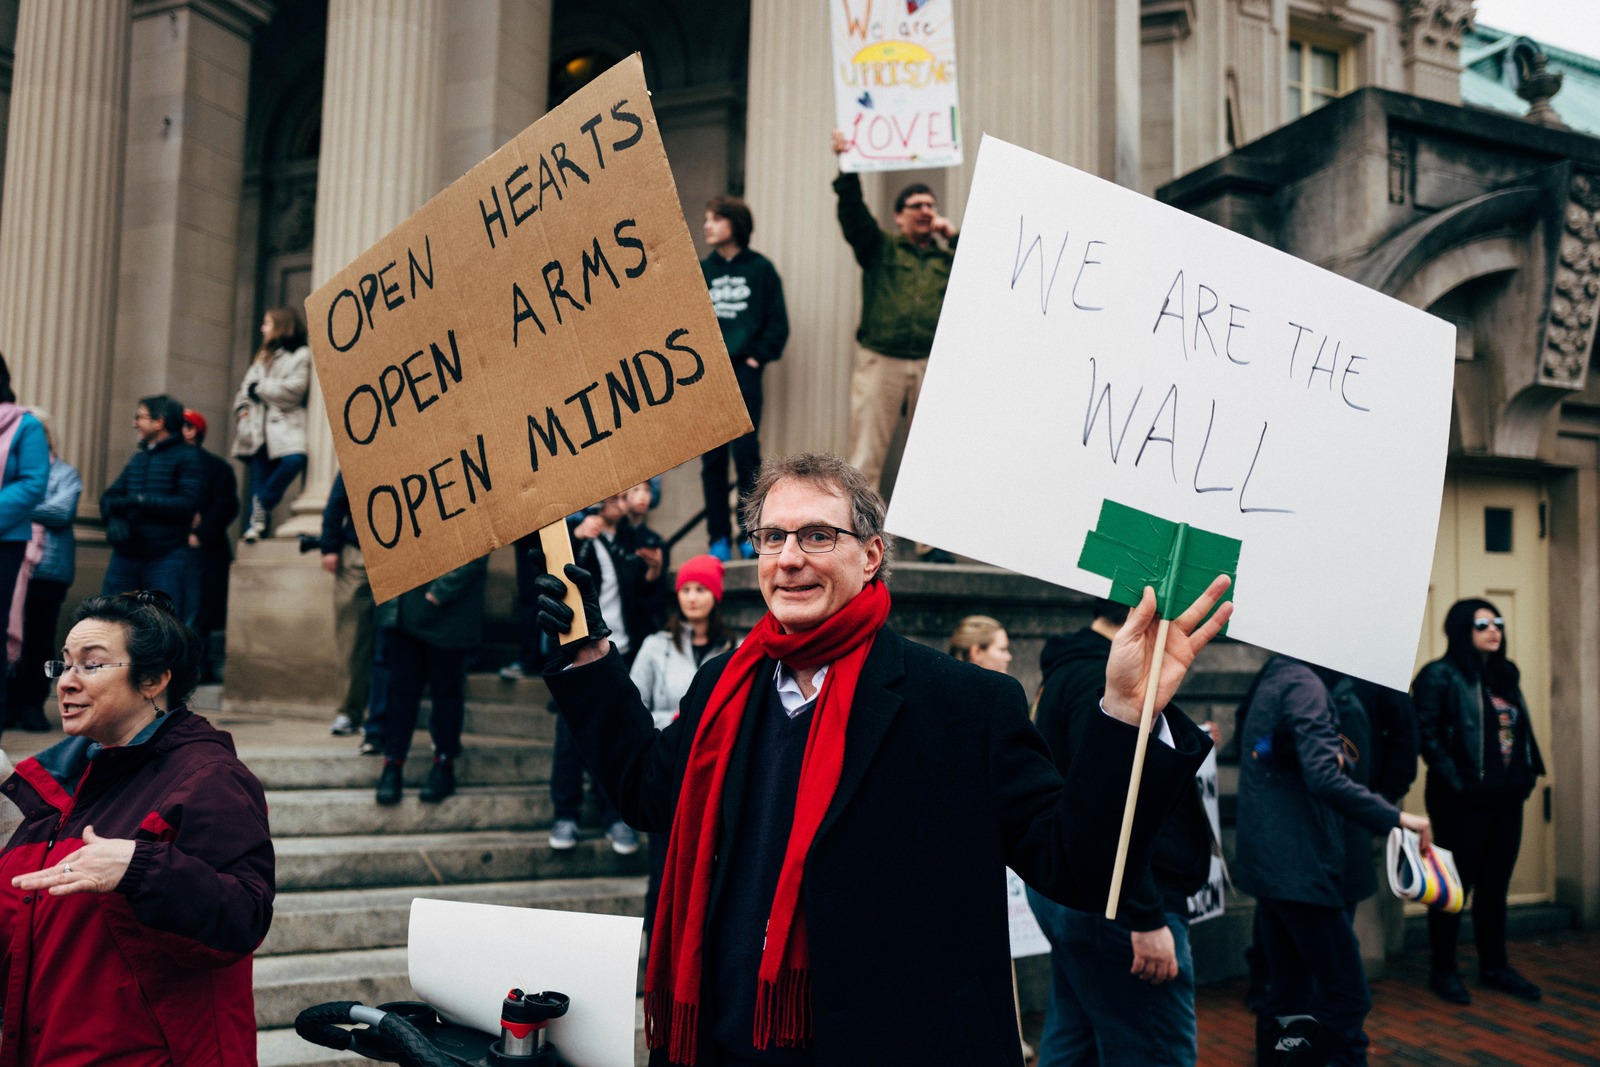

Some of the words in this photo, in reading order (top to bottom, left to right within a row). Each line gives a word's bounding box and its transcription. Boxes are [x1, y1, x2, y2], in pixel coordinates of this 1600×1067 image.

[842, 0, 883, 40] We
[899, 22, 934, 36] are
[328, 235, 435, 353] OPEN
[479, 99, 644, 249] HEARTS
[844, 106, 958, 160] LOVE!
[343, 329, 463, 446] OPEN
[512, 218, 648, 348] ARMS
[1010, 214, 1108, 316] WE
[1152, 269, 1251, 366] ARE
[1289, 322, 1370, 411] THE
[367, 434, 493, 550] OPEN
[527, 328, 705, 472] MINDS
[1082, 357, 1297, 514] WALL
